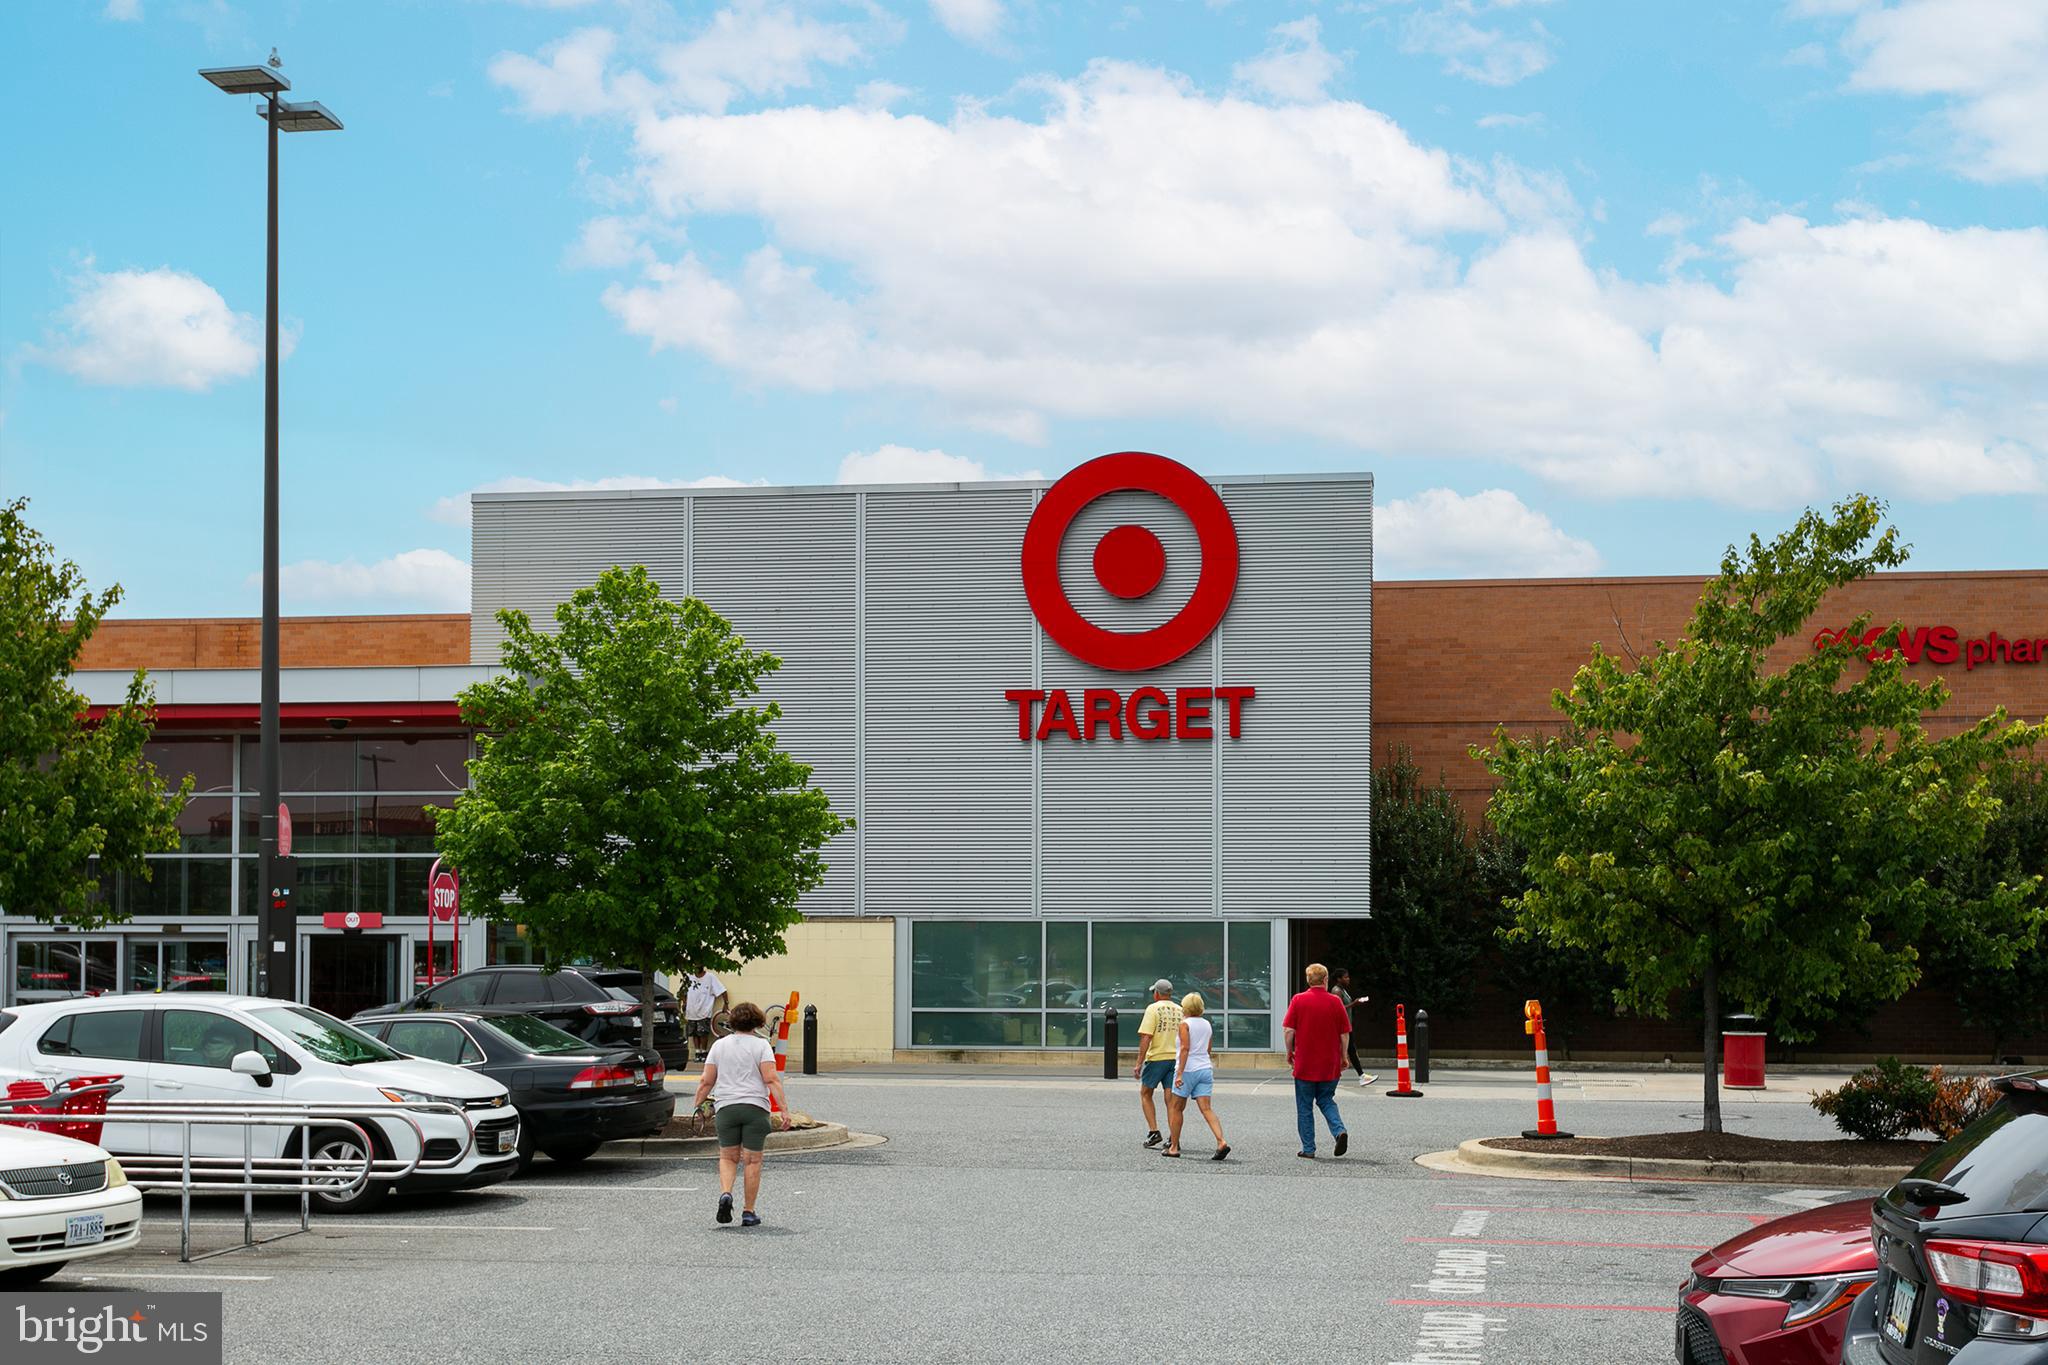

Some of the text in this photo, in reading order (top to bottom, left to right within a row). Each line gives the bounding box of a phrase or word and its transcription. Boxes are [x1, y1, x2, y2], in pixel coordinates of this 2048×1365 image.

[1861, 626, 1961, 665] CVS
[1005, 686, 1256, 741] TARGET
[434, 888, 455, 908] STOP
